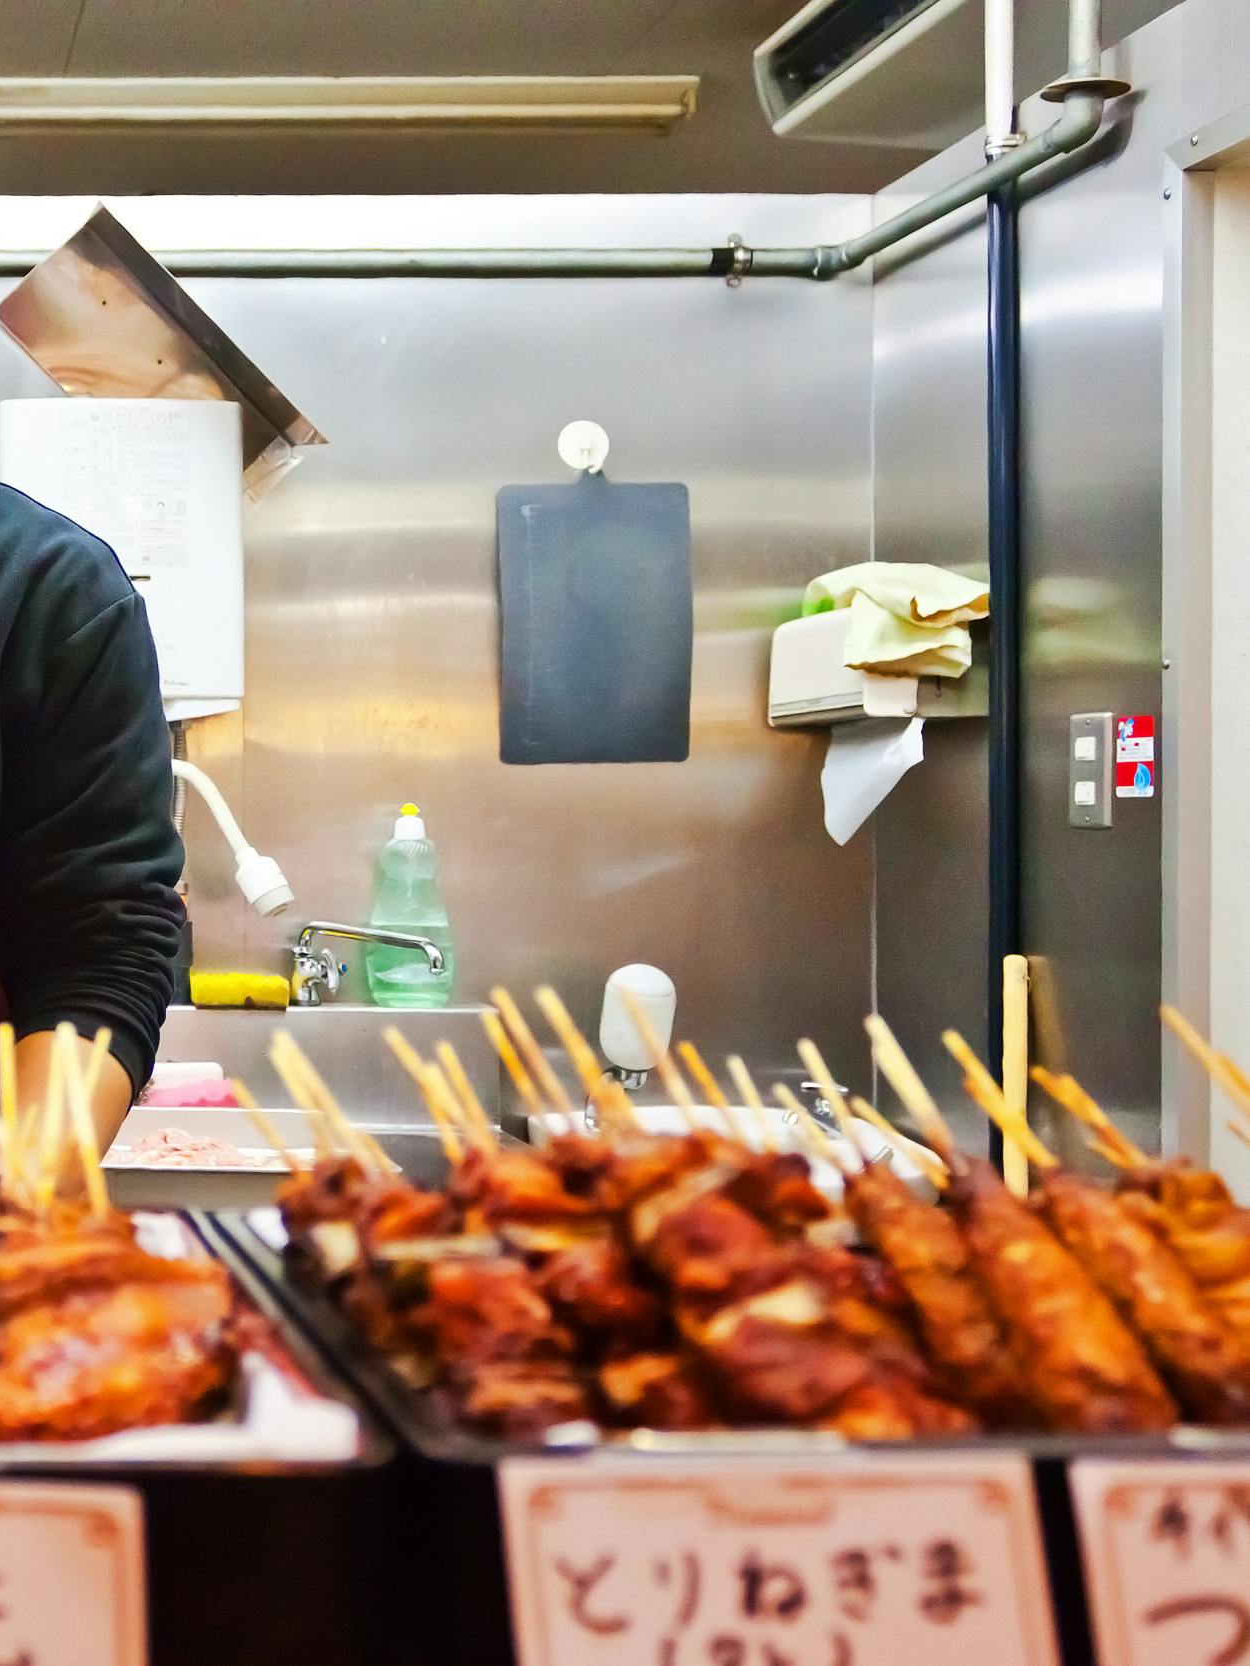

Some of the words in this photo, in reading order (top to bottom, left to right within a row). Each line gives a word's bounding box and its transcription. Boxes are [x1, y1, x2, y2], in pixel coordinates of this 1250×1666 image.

[553, 1536, 980, 1636] とりねぎま
